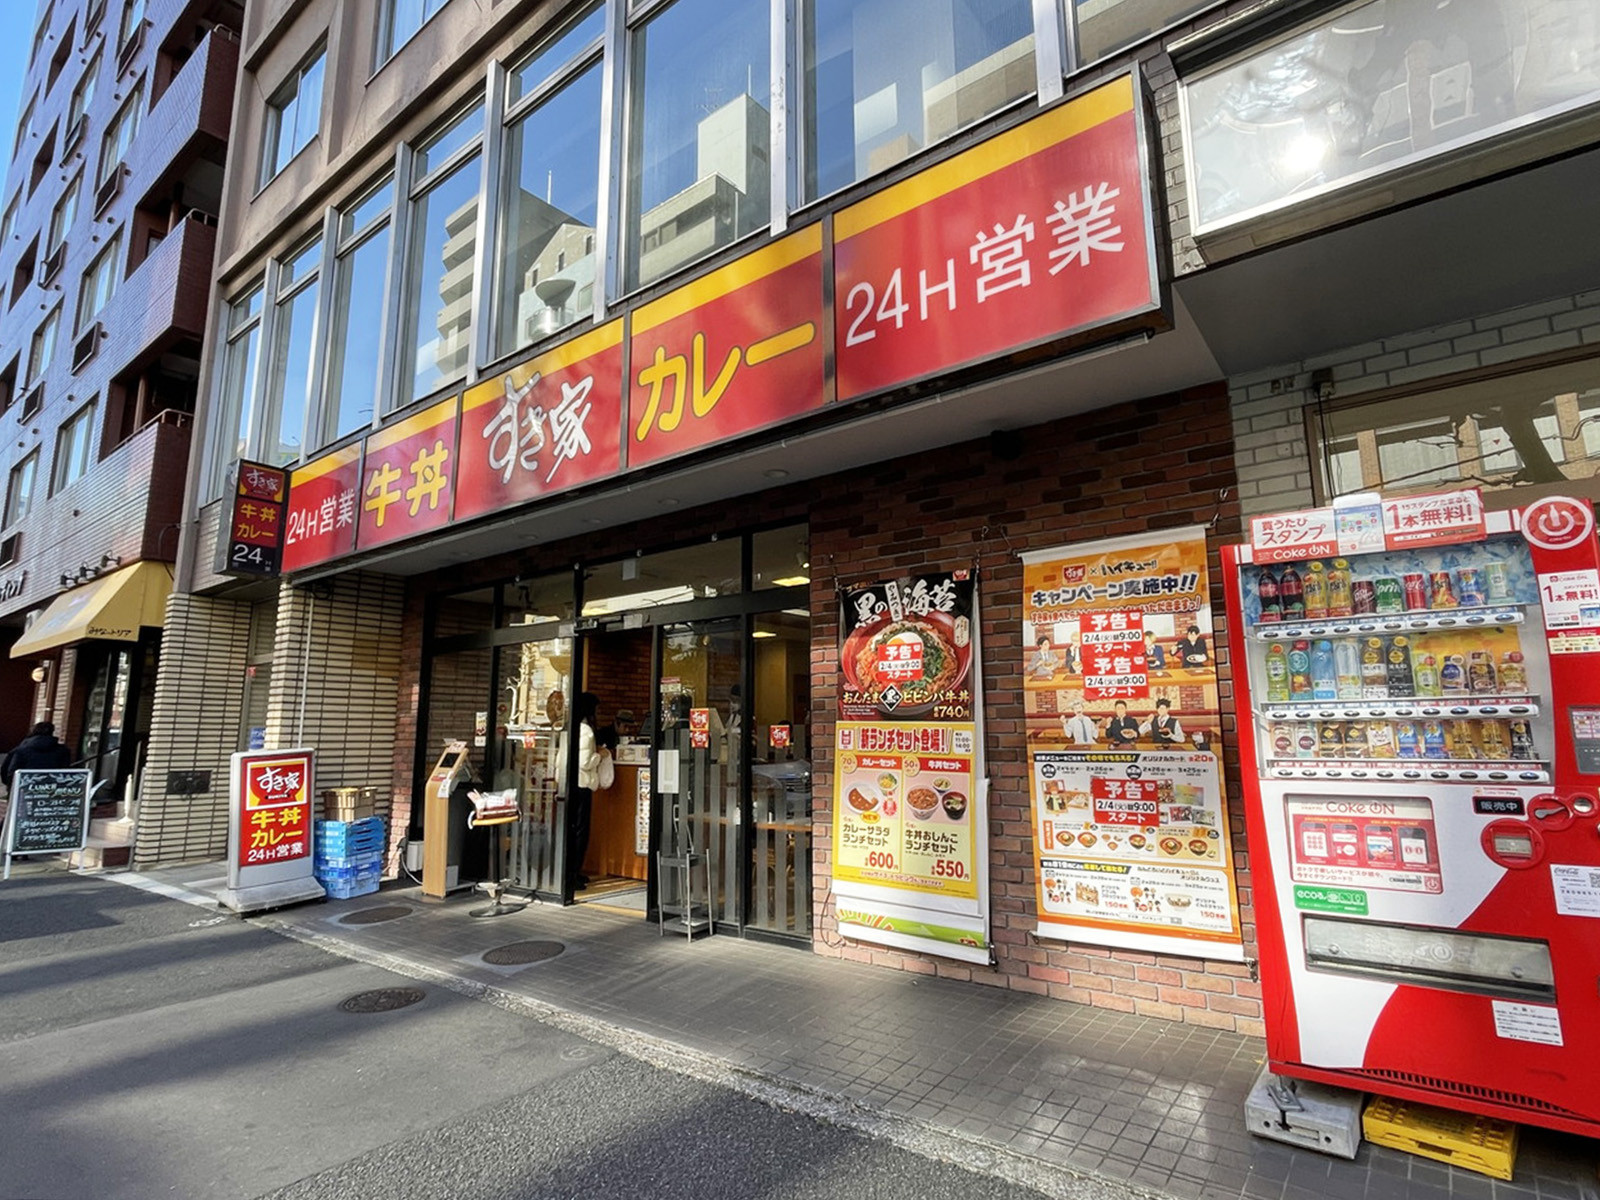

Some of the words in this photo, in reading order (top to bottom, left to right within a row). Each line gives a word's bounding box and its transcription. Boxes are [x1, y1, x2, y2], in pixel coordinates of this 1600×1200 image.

[845, 181, 1126, 348] 24H営業
[635, 320, 816, 442] カレー
[482, 370, 594, 485] すき家
[246, 468, 279, 492] すき家
[364, 440, 449, 528] 牛丼
[240, 503, 276, 523] 牛丼
[286, 488, 355, 545] 24H営業
[237, 522, 275, 539] カレー
[1261, 517, 1308, 532] 買うたび
[1262, 524, 1327, 546] スタンプ
[232, 543, 263, 564] 24
[1273, 547, 1307, 560] Coke
[902, 578, 957, 617] 海苔
[1032, 573, 1198, 606] キャンペーン実施中!!
[1091, 612, 1128, 631] 予告
[885, 644, 912, 661] 予告
[1094, 642, 1132, 653] スタート
[887, 670, 913, 680] スタート
[1094, 656, 1132, 675] 予告
[1098, 686, 1136, 697] スタート
[256, 766, 300, 795] すき家
[1104, 780, 1143, 799] 予告
[1326, 801, 1367, 814] Coke
[1480, 801, 1518, 811] 販売中
[250, 806, 302, 828] 牛丼
[1108, 811, 1146, 824] スタート
[250, 828, 303, 849] カレー
[843, 833, 889, 847] ランチセット
[904, 829, 958, 844] 牛丼おしんこ
[247, 841, 304, 863] 24H営業
[904, 840, 957, 855] ランチセット
